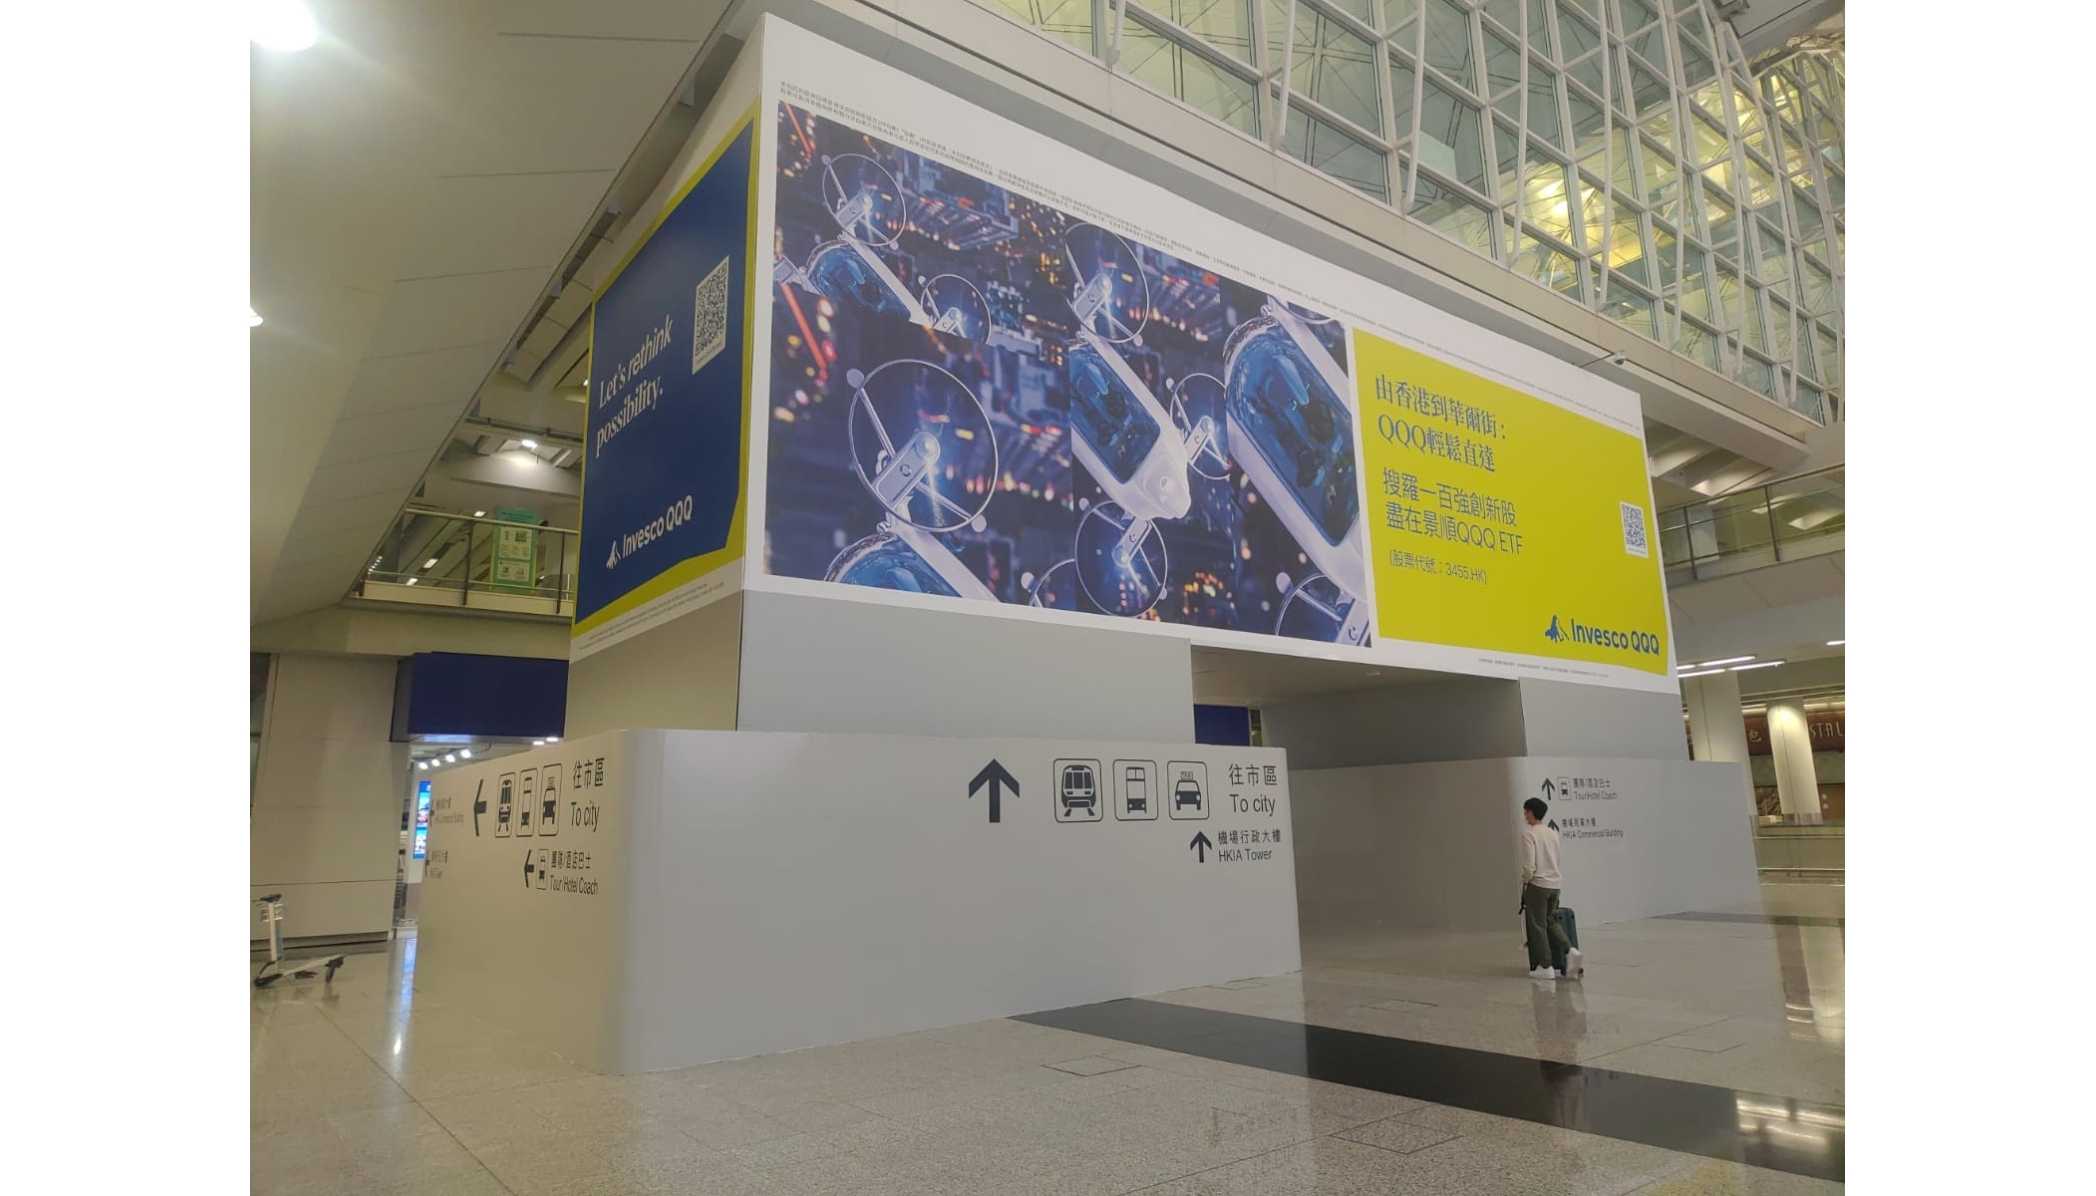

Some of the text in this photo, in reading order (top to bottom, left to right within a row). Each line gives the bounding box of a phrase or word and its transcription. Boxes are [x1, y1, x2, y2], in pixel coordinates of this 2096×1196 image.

[599, 314, 673, 410] Let's rethink
[596, 376, 663, 459] possibility.
[1378, 414, 1495, 473] QQQ輕鬆直達
[1382, 466, 1517, 527] 搜羅一百強創新股
[622, 494, 693, 559] Invesco QQQ
[1385, 501, 1523, 555] 盡在景順QQQ ETF
[1571, 617, 1660, 656] Invesco QQQ
[573, 757, 605, 789] 往市區
[1229, 763, 1278, 787] 往市區
[571, 800, 600, 833] To city
[1229, 794, 1276, 817] To city
[1218, 828, 1281, 845] 機場行政大樓
[1218, 848, 1273, 862] HKIA Tower
[578, 876, 599, 896] Coach
